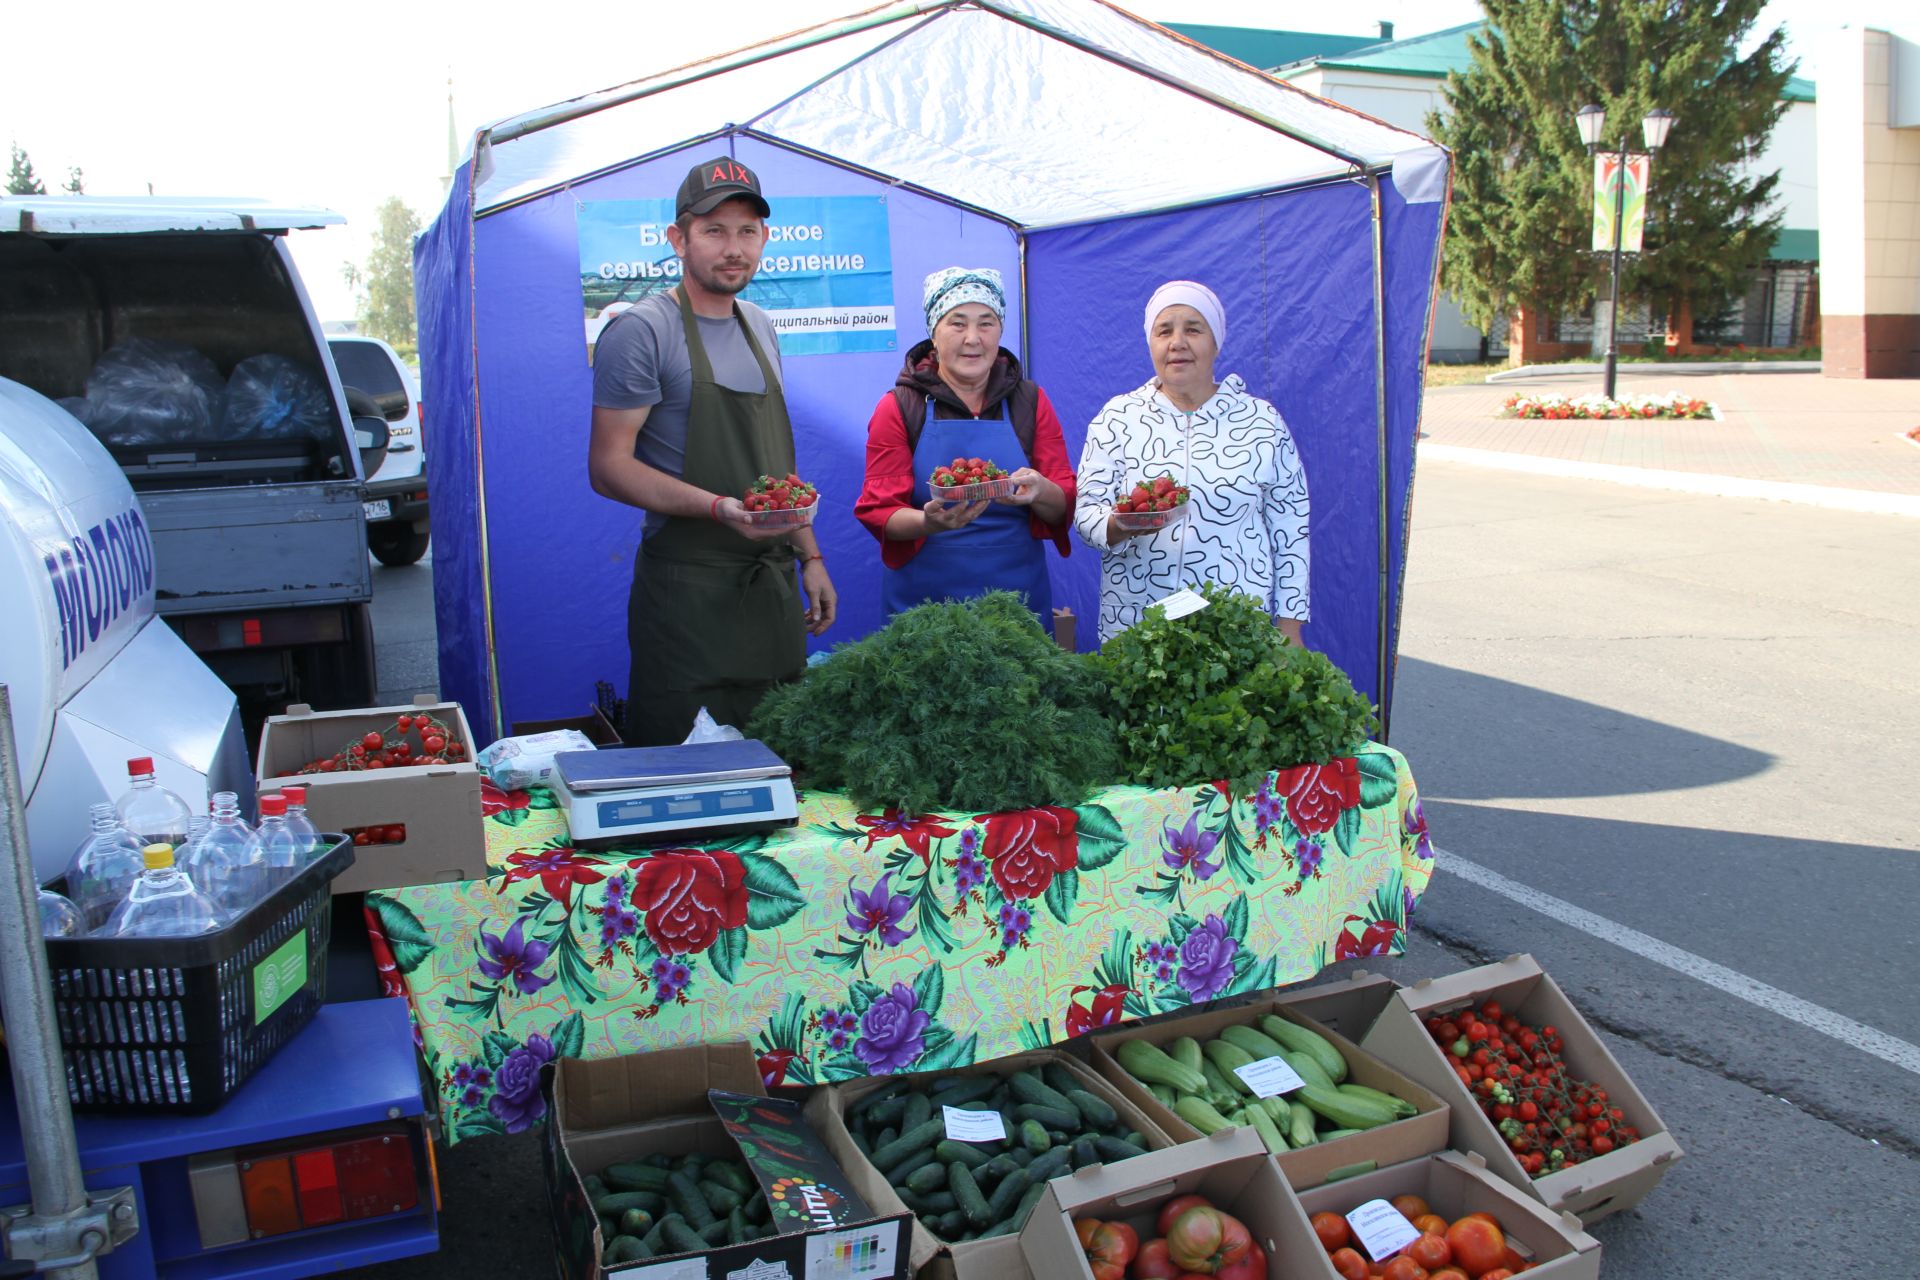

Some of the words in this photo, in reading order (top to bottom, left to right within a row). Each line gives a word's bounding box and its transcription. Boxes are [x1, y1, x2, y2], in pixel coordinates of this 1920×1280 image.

[600, 261, 684, 280] сельс
[757, 254, 865, 273] селение
[853, 312, 889, 327] район
[44, 508, 152, 671] МОЛОКО
[799, 1185, 836, 1229] LITTA
